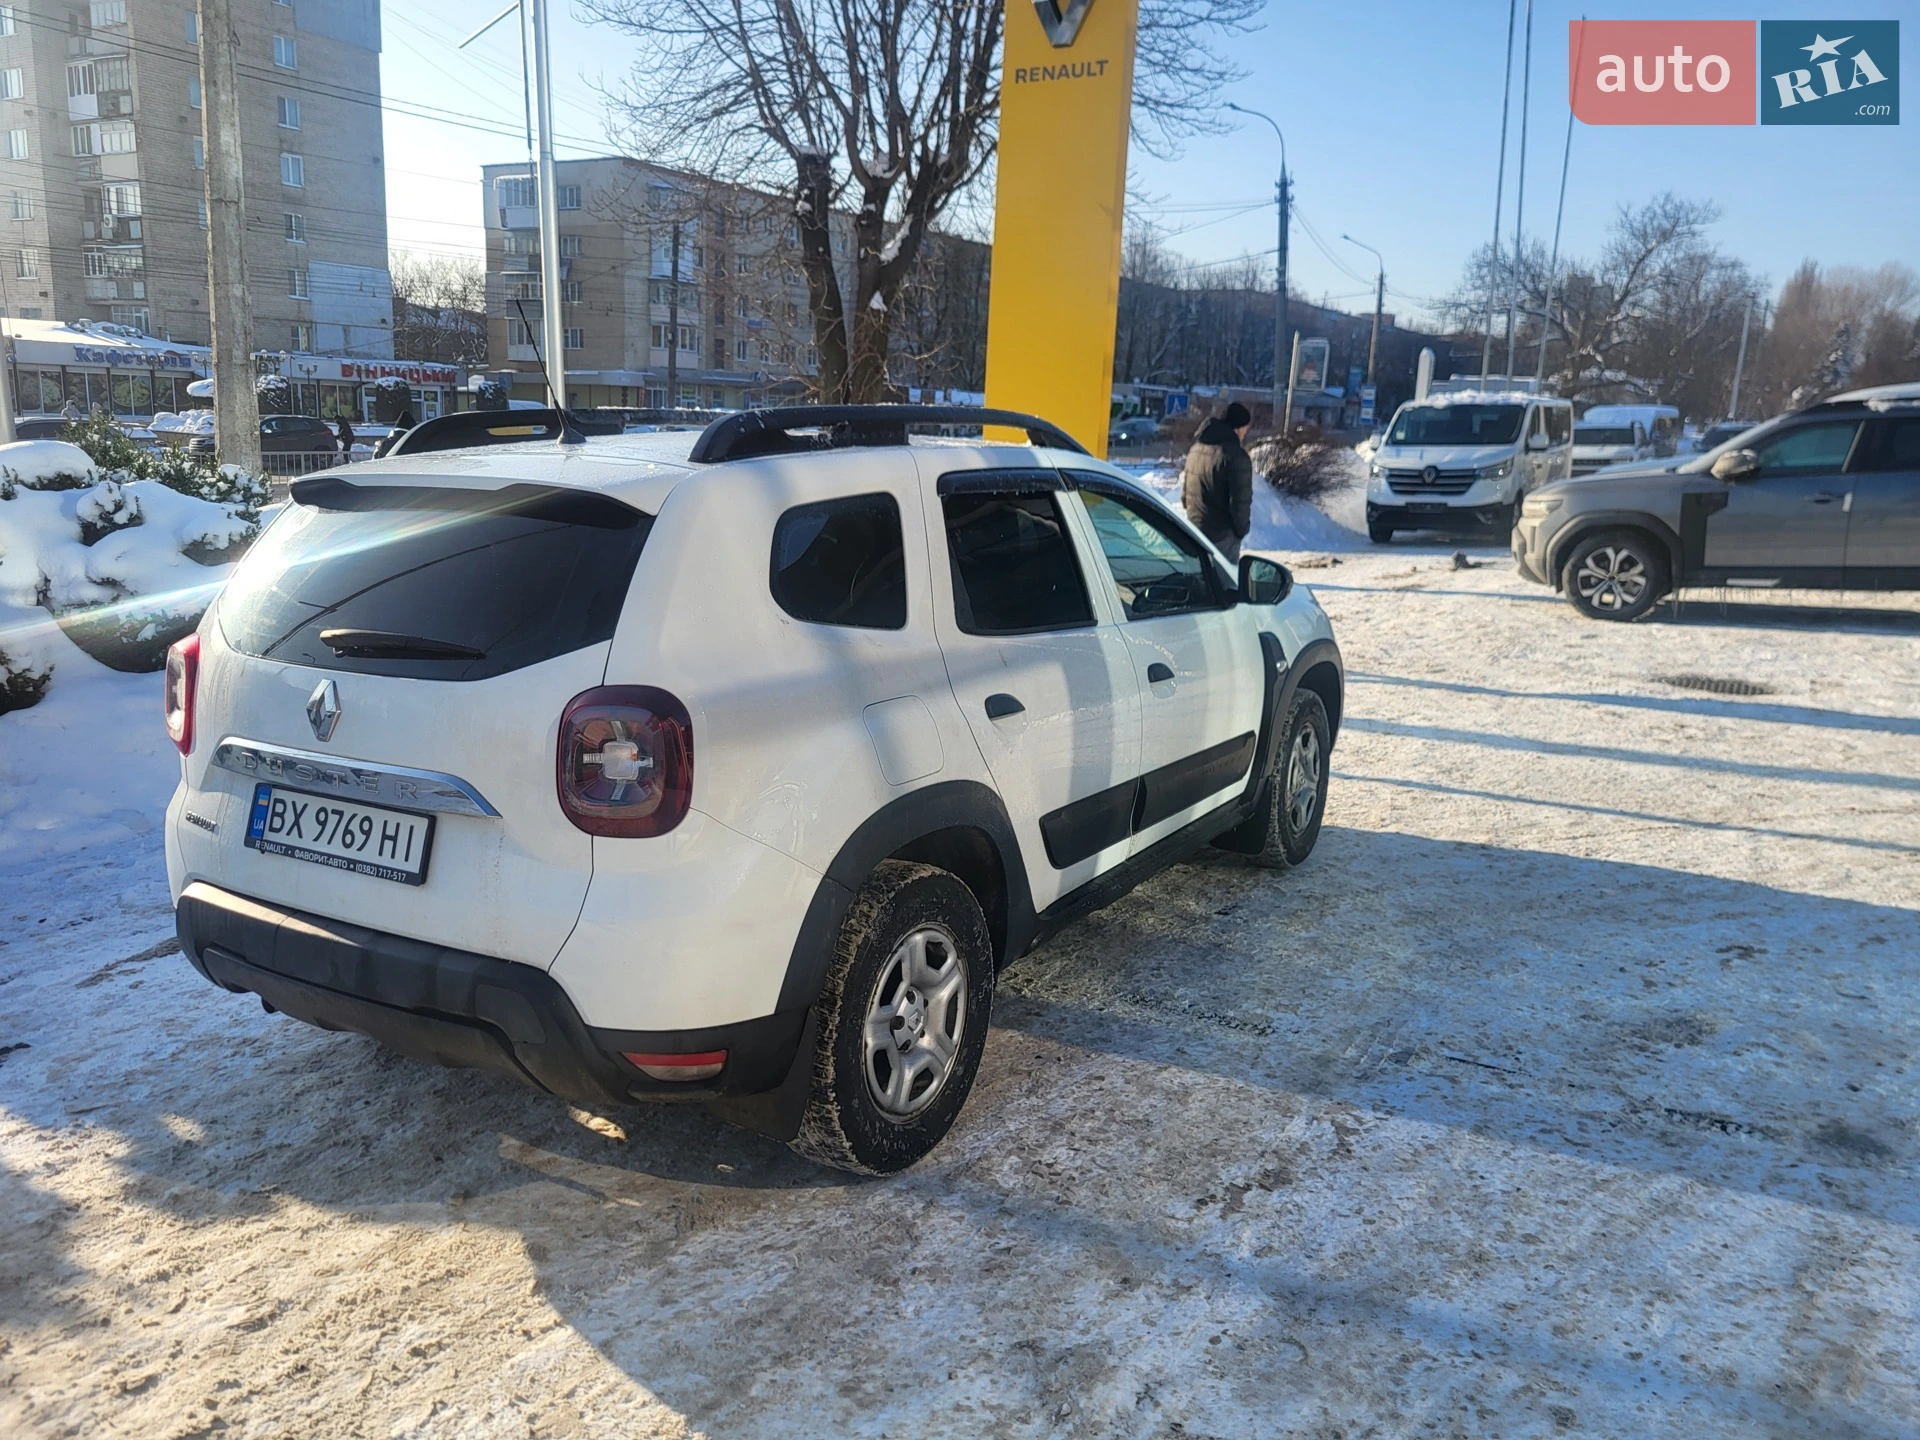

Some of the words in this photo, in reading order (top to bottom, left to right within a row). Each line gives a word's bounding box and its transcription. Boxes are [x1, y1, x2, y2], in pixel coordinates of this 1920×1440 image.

[1015, 60, 1109, 84] RENAULT
[241, 751, 418, 799] DUSTER
[253, 818, 264, 831] UA
[268, 797, 309, 839] BX
[312, 806, 373, 852] 9769
[378, 819, 414, 862] HI
[294, 849, 348, 869] ФАВОРИТ-АВТО
[355, 862, 378, 877] (0382)
[378, 867, 407, 882] 717-517
